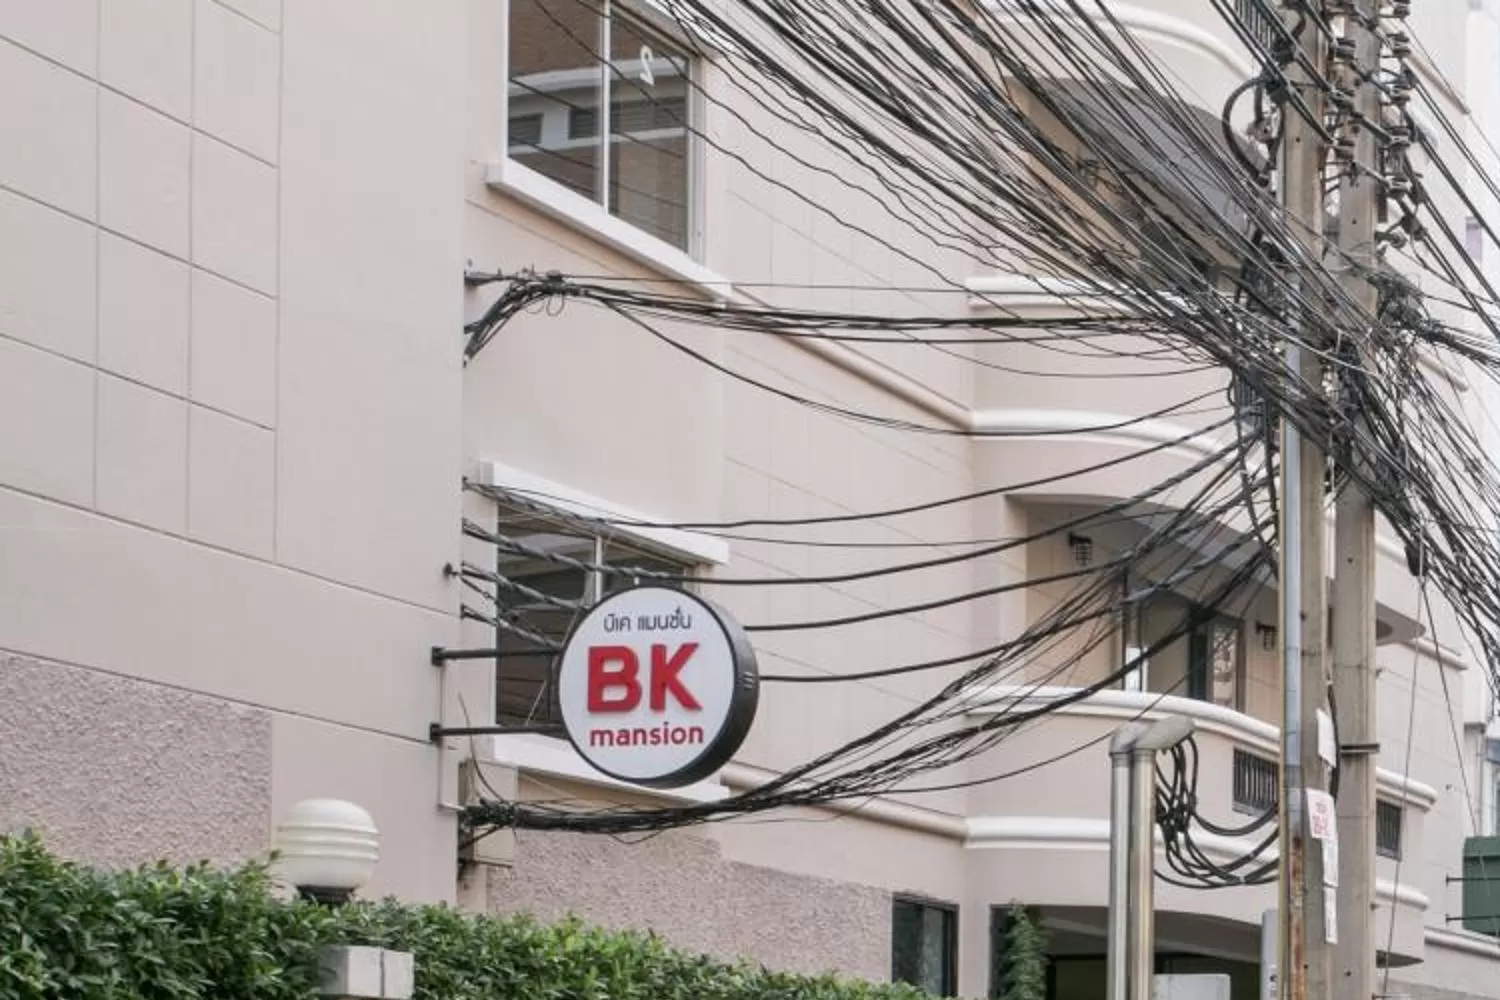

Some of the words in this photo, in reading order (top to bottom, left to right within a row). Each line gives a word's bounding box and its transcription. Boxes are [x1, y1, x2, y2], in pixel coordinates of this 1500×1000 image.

[637, 606, 691, 630] แมนชั่น
[588, 643, 703, 713] BK
[590, 721, 704, 746] mansion
